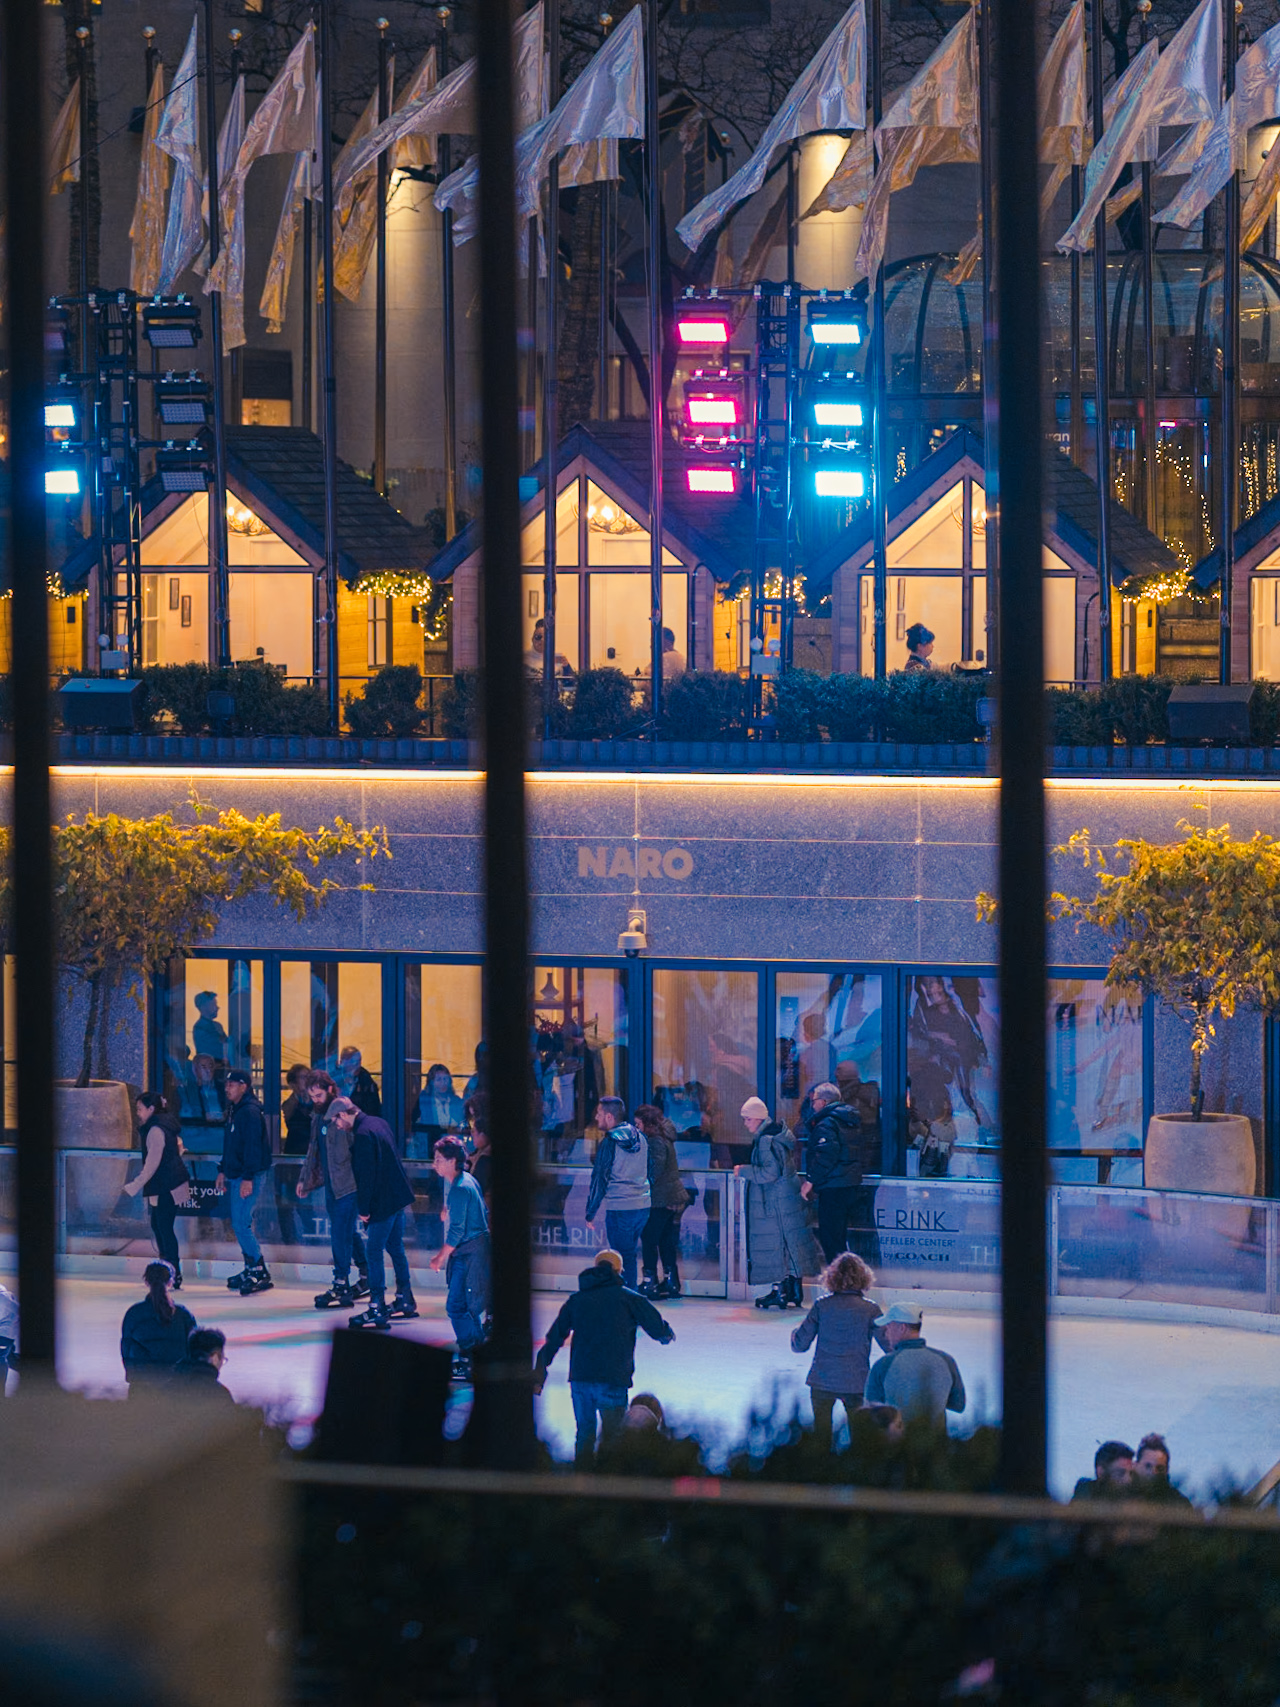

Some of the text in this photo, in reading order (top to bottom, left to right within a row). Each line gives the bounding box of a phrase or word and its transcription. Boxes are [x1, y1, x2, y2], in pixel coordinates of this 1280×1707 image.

[578, 846, 694, 881] NARO
[895, 1209, 947, 1230] RINK
[572, 1226, 604, 1246] RIN
[895, 1252, 950, 1261] COACH
[971, 1245, 997, 1265] TH
